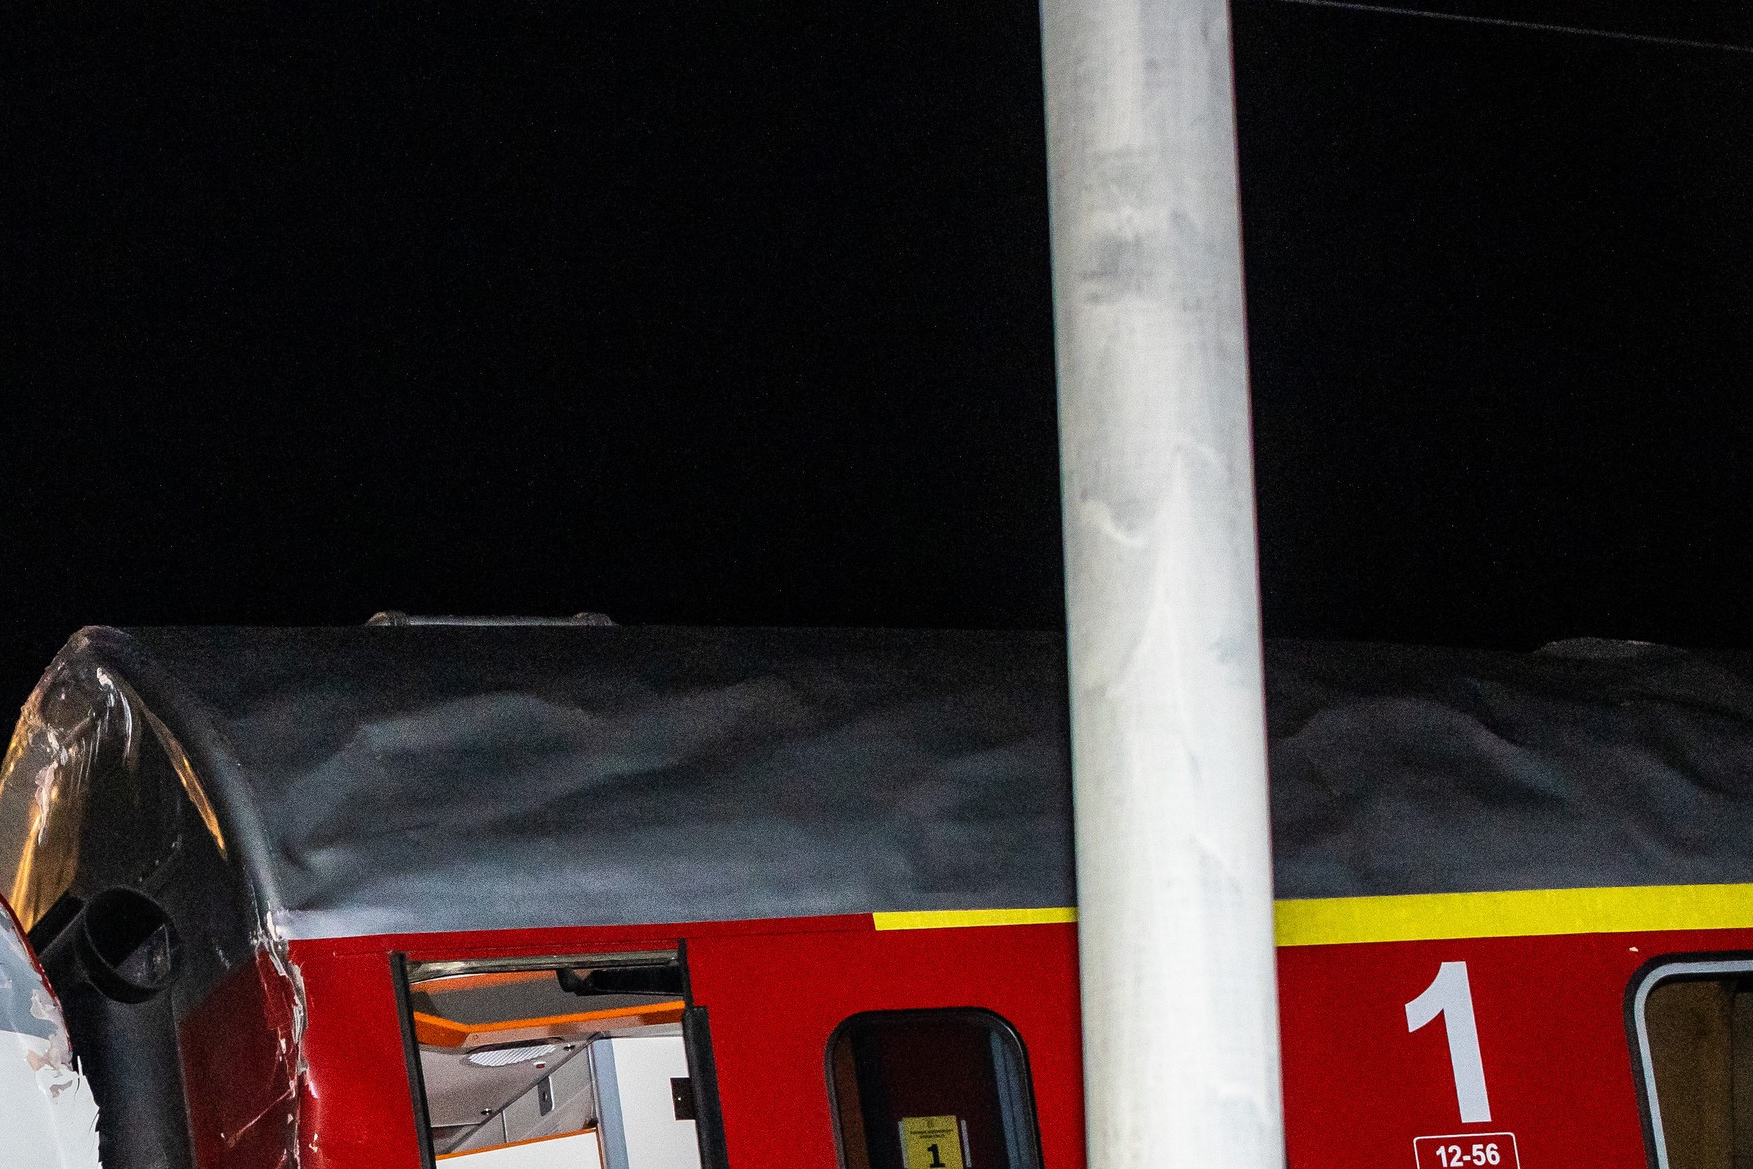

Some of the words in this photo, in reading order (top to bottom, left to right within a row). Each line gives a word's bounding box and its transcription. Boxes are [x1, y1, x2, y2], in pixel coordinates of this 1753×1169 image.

[1405, 961, 1492, 1124] 1
[927, 1143, 946, 1168] 1
[1435, 1142, 1501, 1168] 12-56
